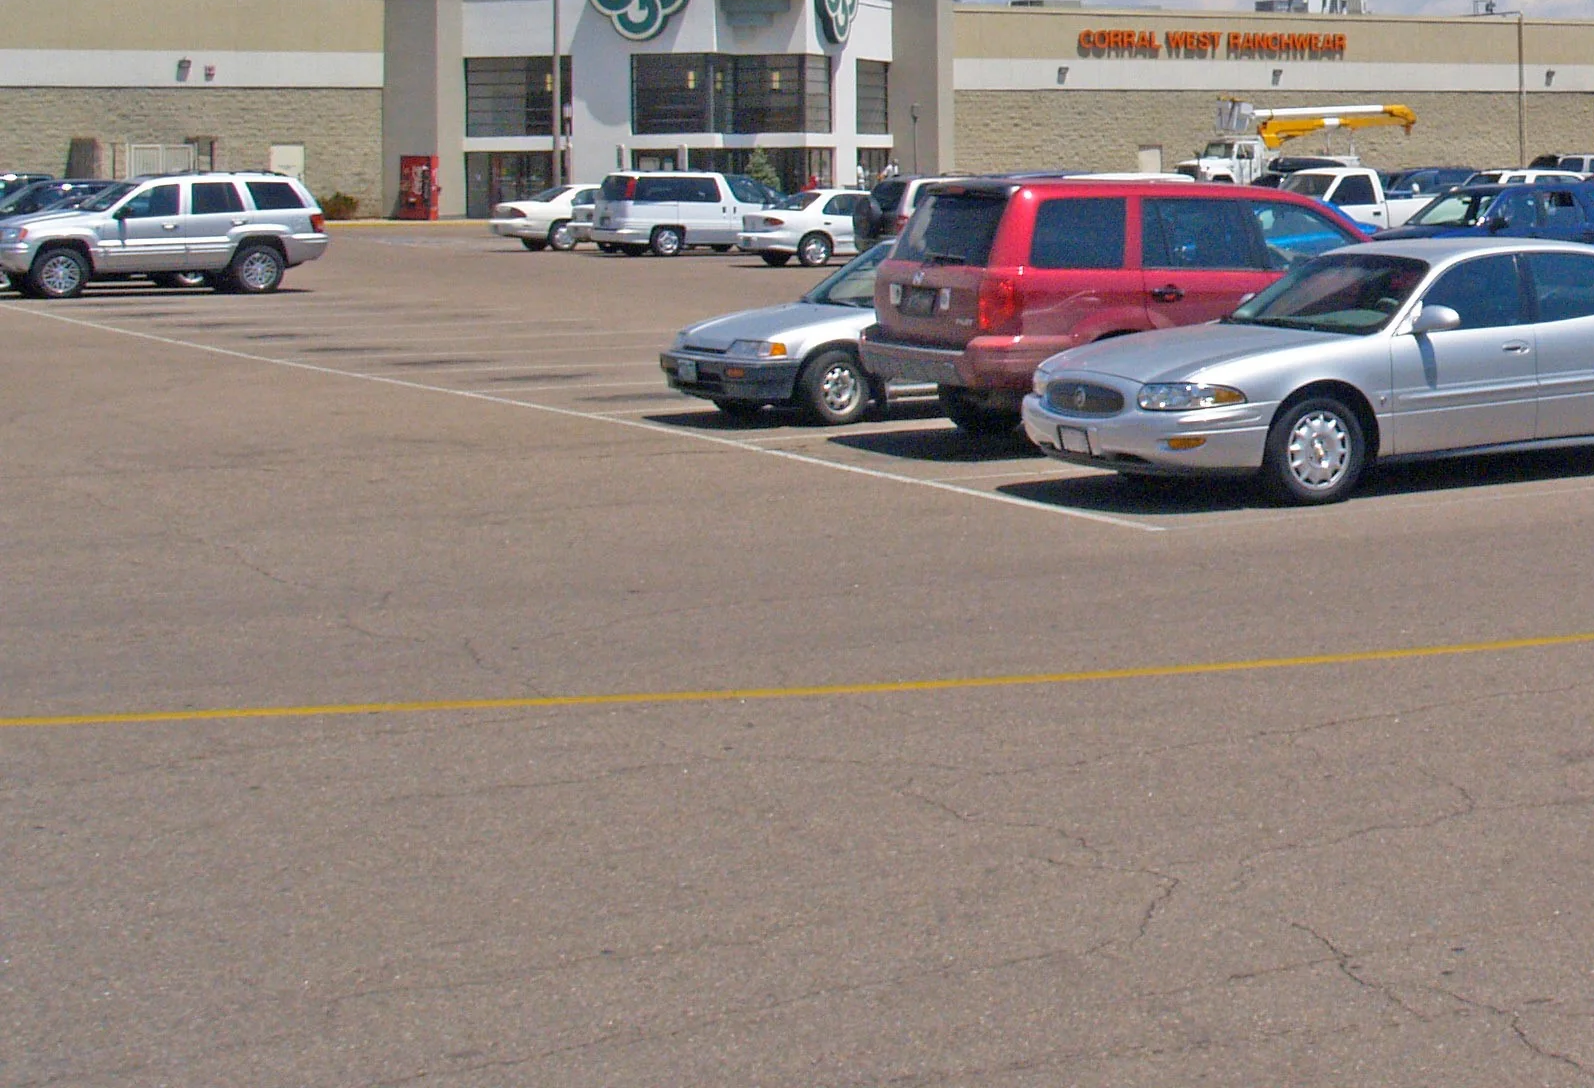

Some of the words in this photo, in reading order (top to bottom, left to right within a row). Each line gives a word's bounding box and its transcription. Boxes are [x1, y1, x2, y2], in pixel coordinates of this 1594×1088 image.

[1078, 29, 1161, 49] CORRAL
[1167, 31, 1222, 50] WEST
[1227, 32, 1347, 51] RANCHWEAR
